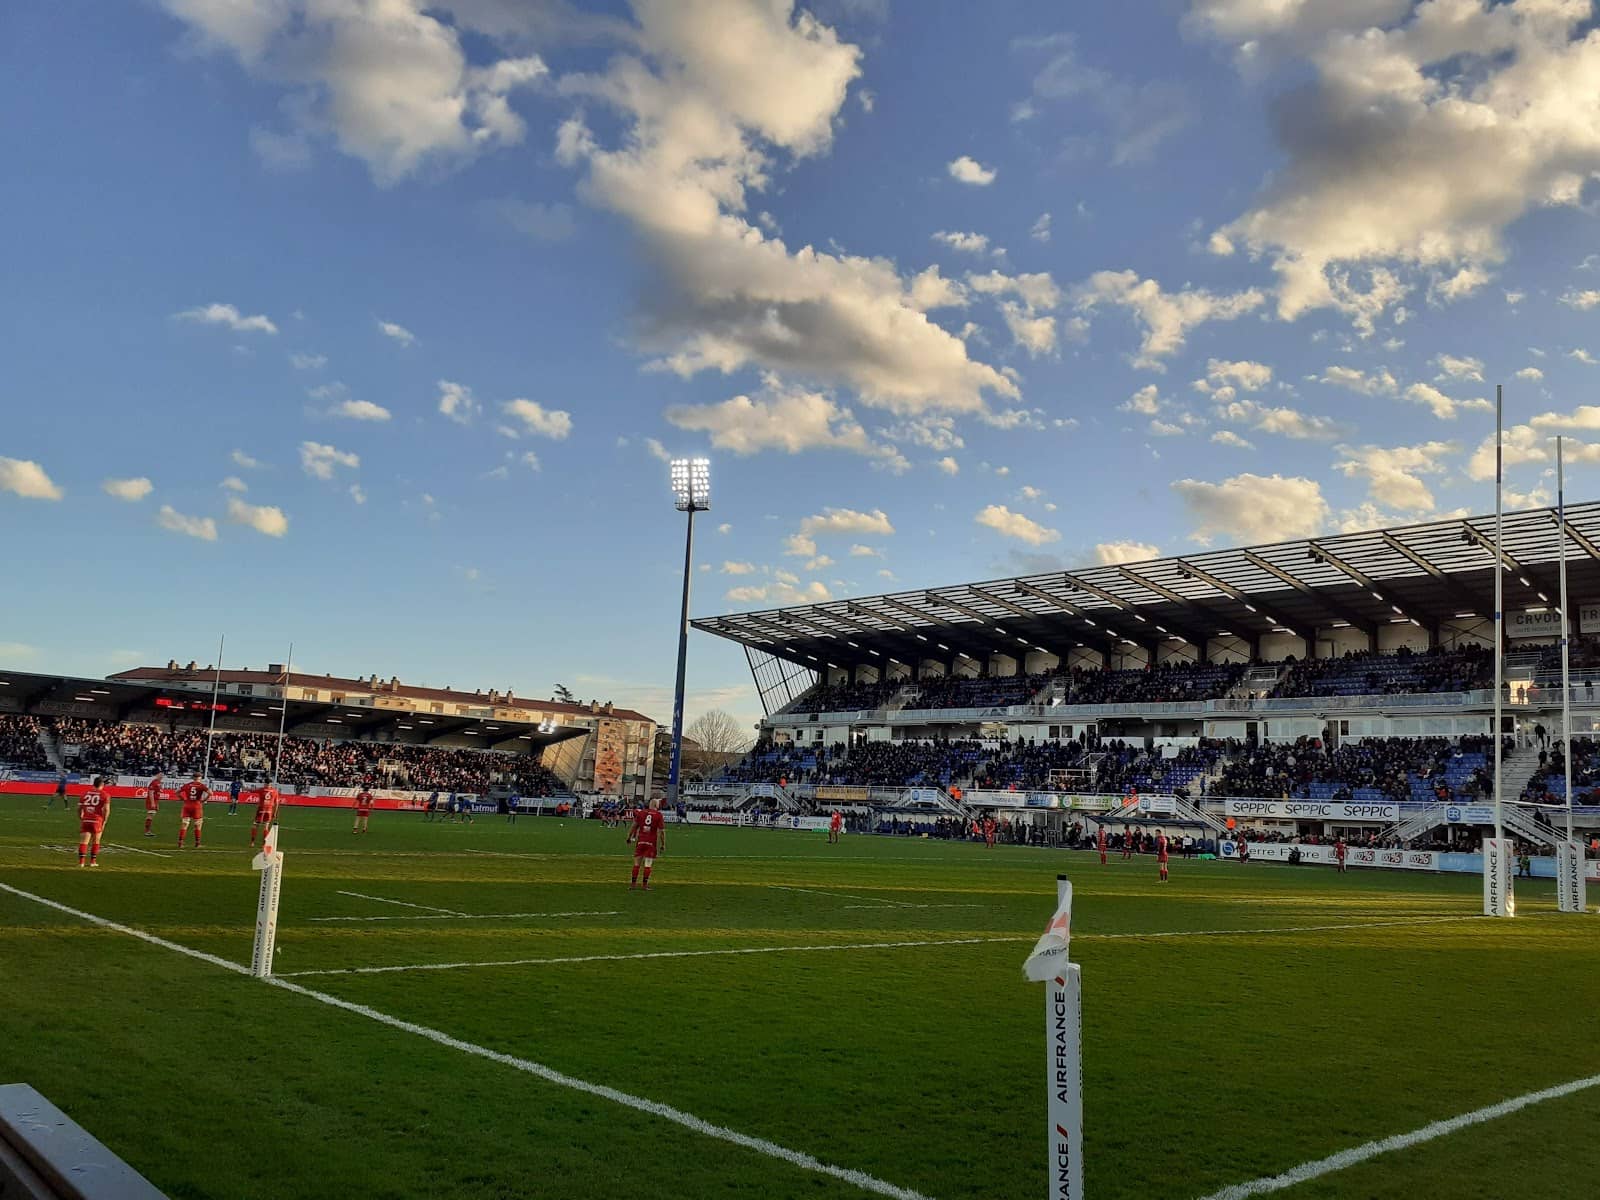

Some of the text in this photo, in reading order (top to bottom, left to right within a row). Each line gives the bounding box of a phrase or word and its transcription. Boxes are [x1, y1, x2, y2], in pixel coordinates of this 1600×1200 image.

[190, 786, 197, 795] 5
[264, 792, 272, 800] 6
[84, 794, 100, 806] 20
[645, 814, 652, 825] 8
[1280, 847, 1319, 859] Fbre
[1490, 850, 1498, 916] AIRFRANCE
[1570, 852, 1580, 912] AIRFRANCE
[260, 867, 269, 912] AIRFRANC
[1054, 990, 1069, 1104] AIRFRANCE
